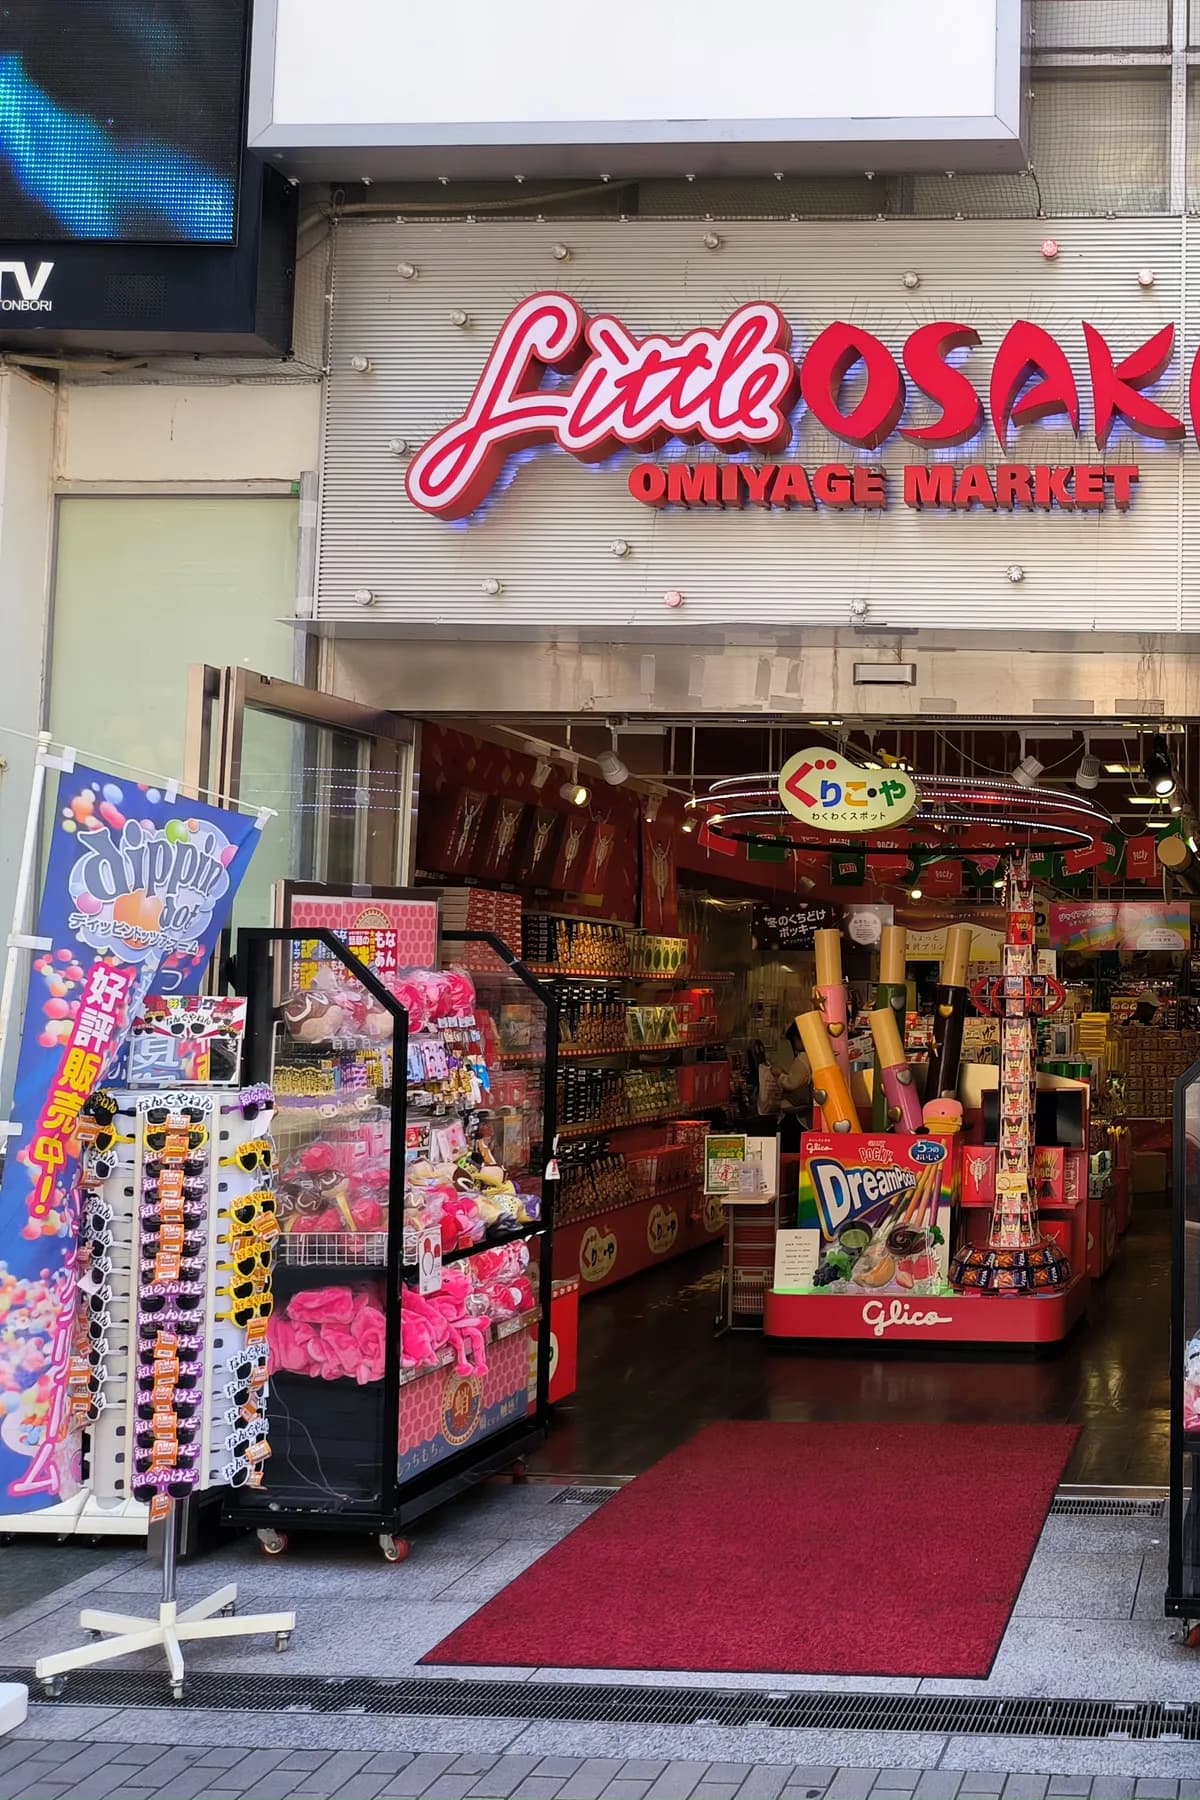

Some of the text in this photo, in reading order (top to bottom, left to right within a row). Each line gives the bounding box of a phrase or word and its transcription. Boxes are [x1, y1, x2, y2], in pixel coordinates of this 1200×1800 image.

[406, 291, 800, 516] Little
[629, 463, 1139, 511] OMIYAGE MARKET
[811, 811, 887, 821] わくわくスポット
[77, 819, 224, 902] dippin
[766, 909, 826, 928] 冬のくちどけ
[779, 925, 818, 938] ポッキー
[138, 1092, 213, 1114] なんでやねん
[140, 1281, 205, 1297] 知らんけど
[139, 1309, 204, 1324] 知らんけど
[132, 1469, 198, 1487] 知らんけど
